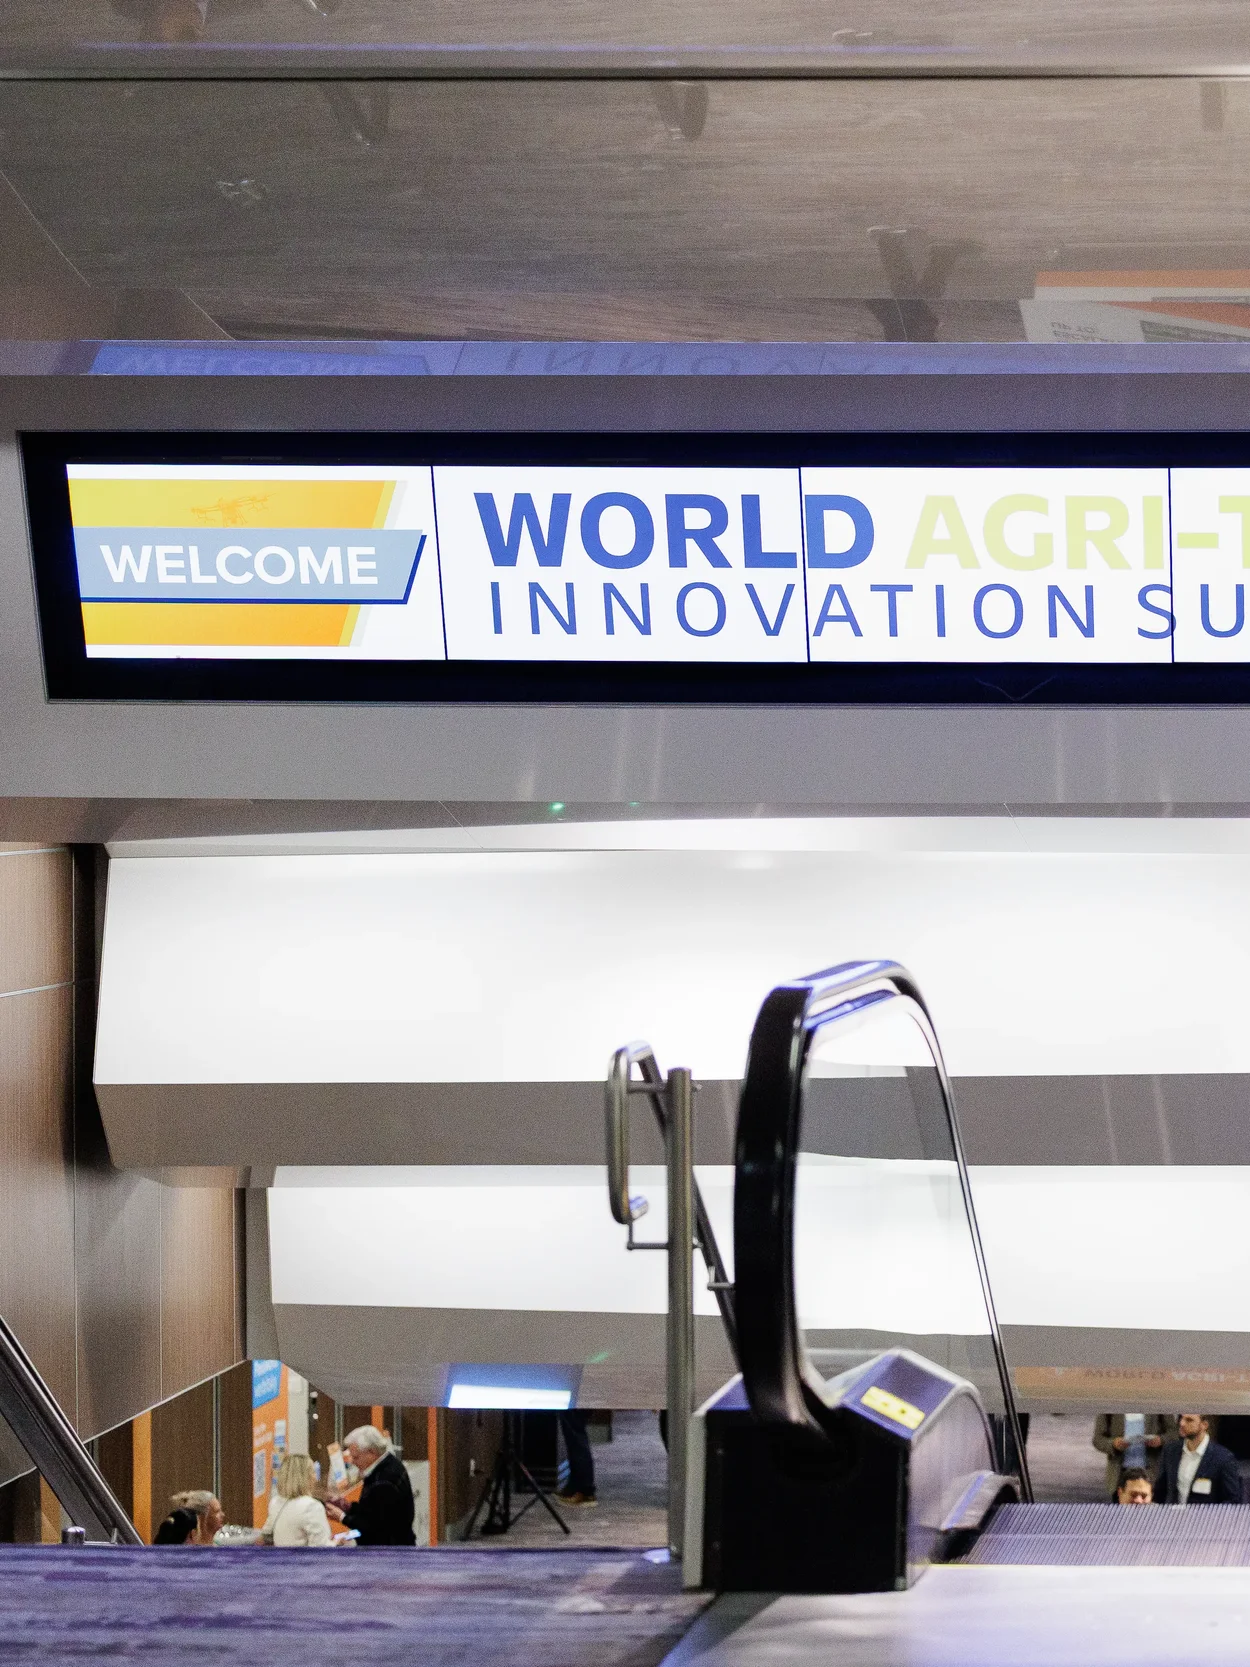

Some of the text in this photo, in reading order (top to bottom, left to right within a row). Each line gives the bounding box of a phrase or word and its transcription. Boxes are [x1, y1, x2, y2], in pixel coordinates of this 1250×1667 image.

[474, 492, 875, 569] WORLD
[99, 545, 378, 585] WELCOME
[490, 582, 1095, 638] INNOVATION
